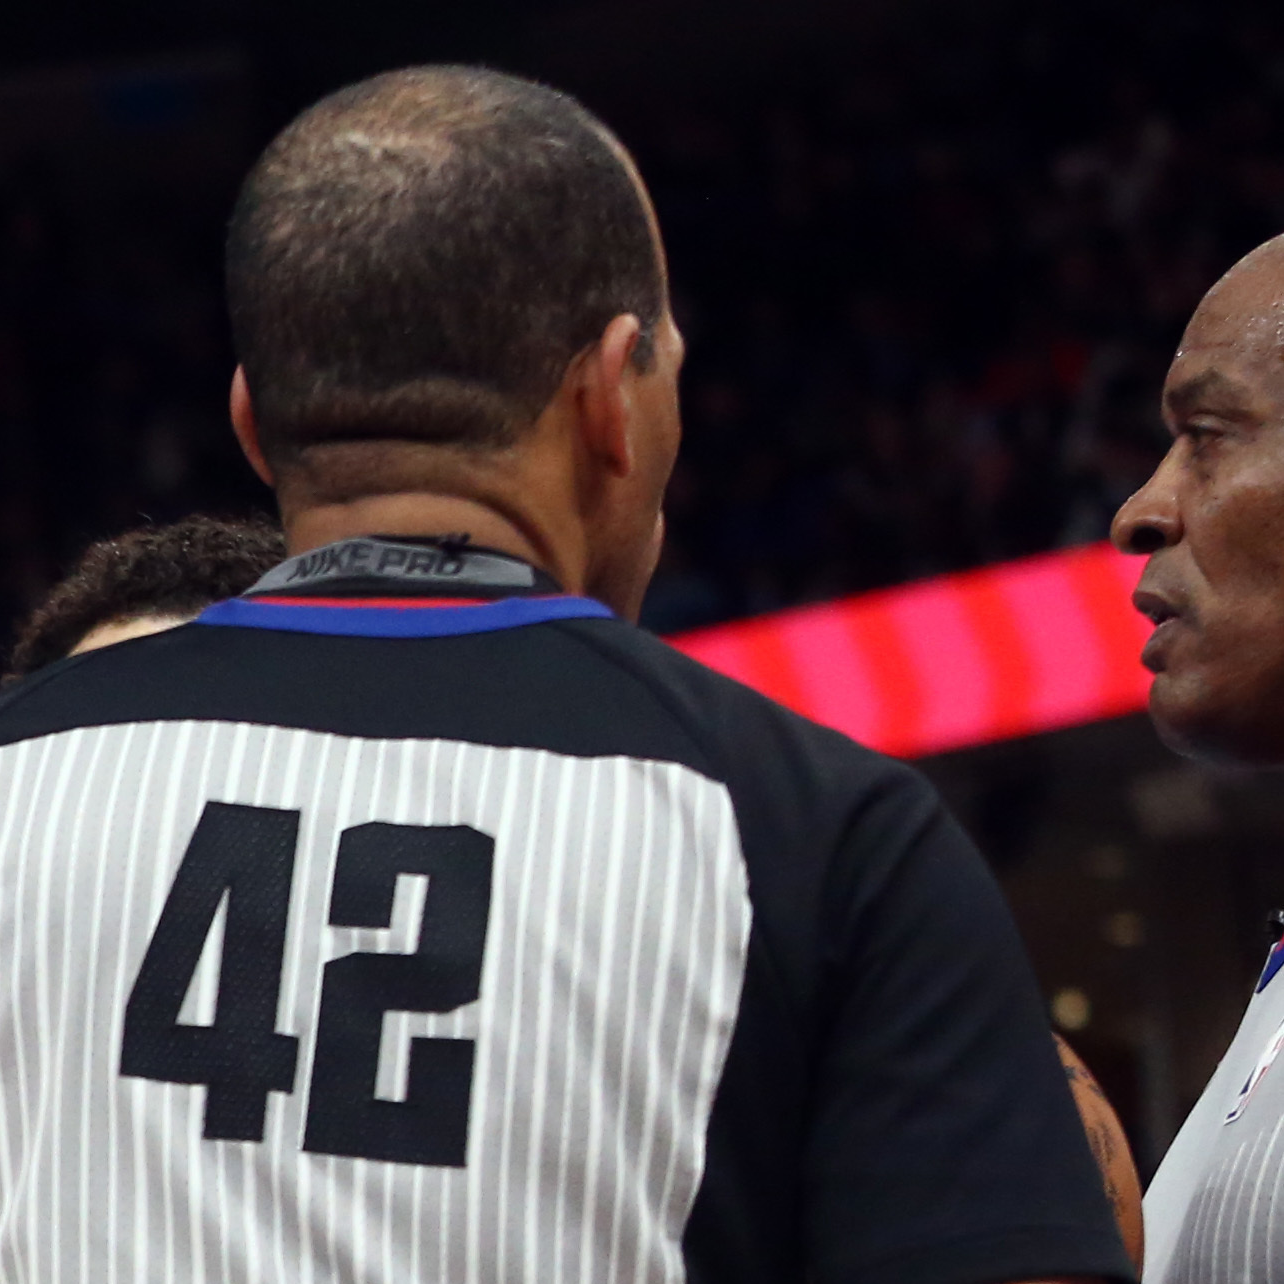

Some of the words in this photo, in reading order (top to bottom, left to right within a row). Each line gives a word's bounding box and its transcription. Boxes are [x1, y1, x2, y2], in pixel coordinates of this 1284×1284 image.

[286, 541, 375, 582] NIKE
[380, 546, 466, 575] PRO
[119, 800, 495, 1167] 42
